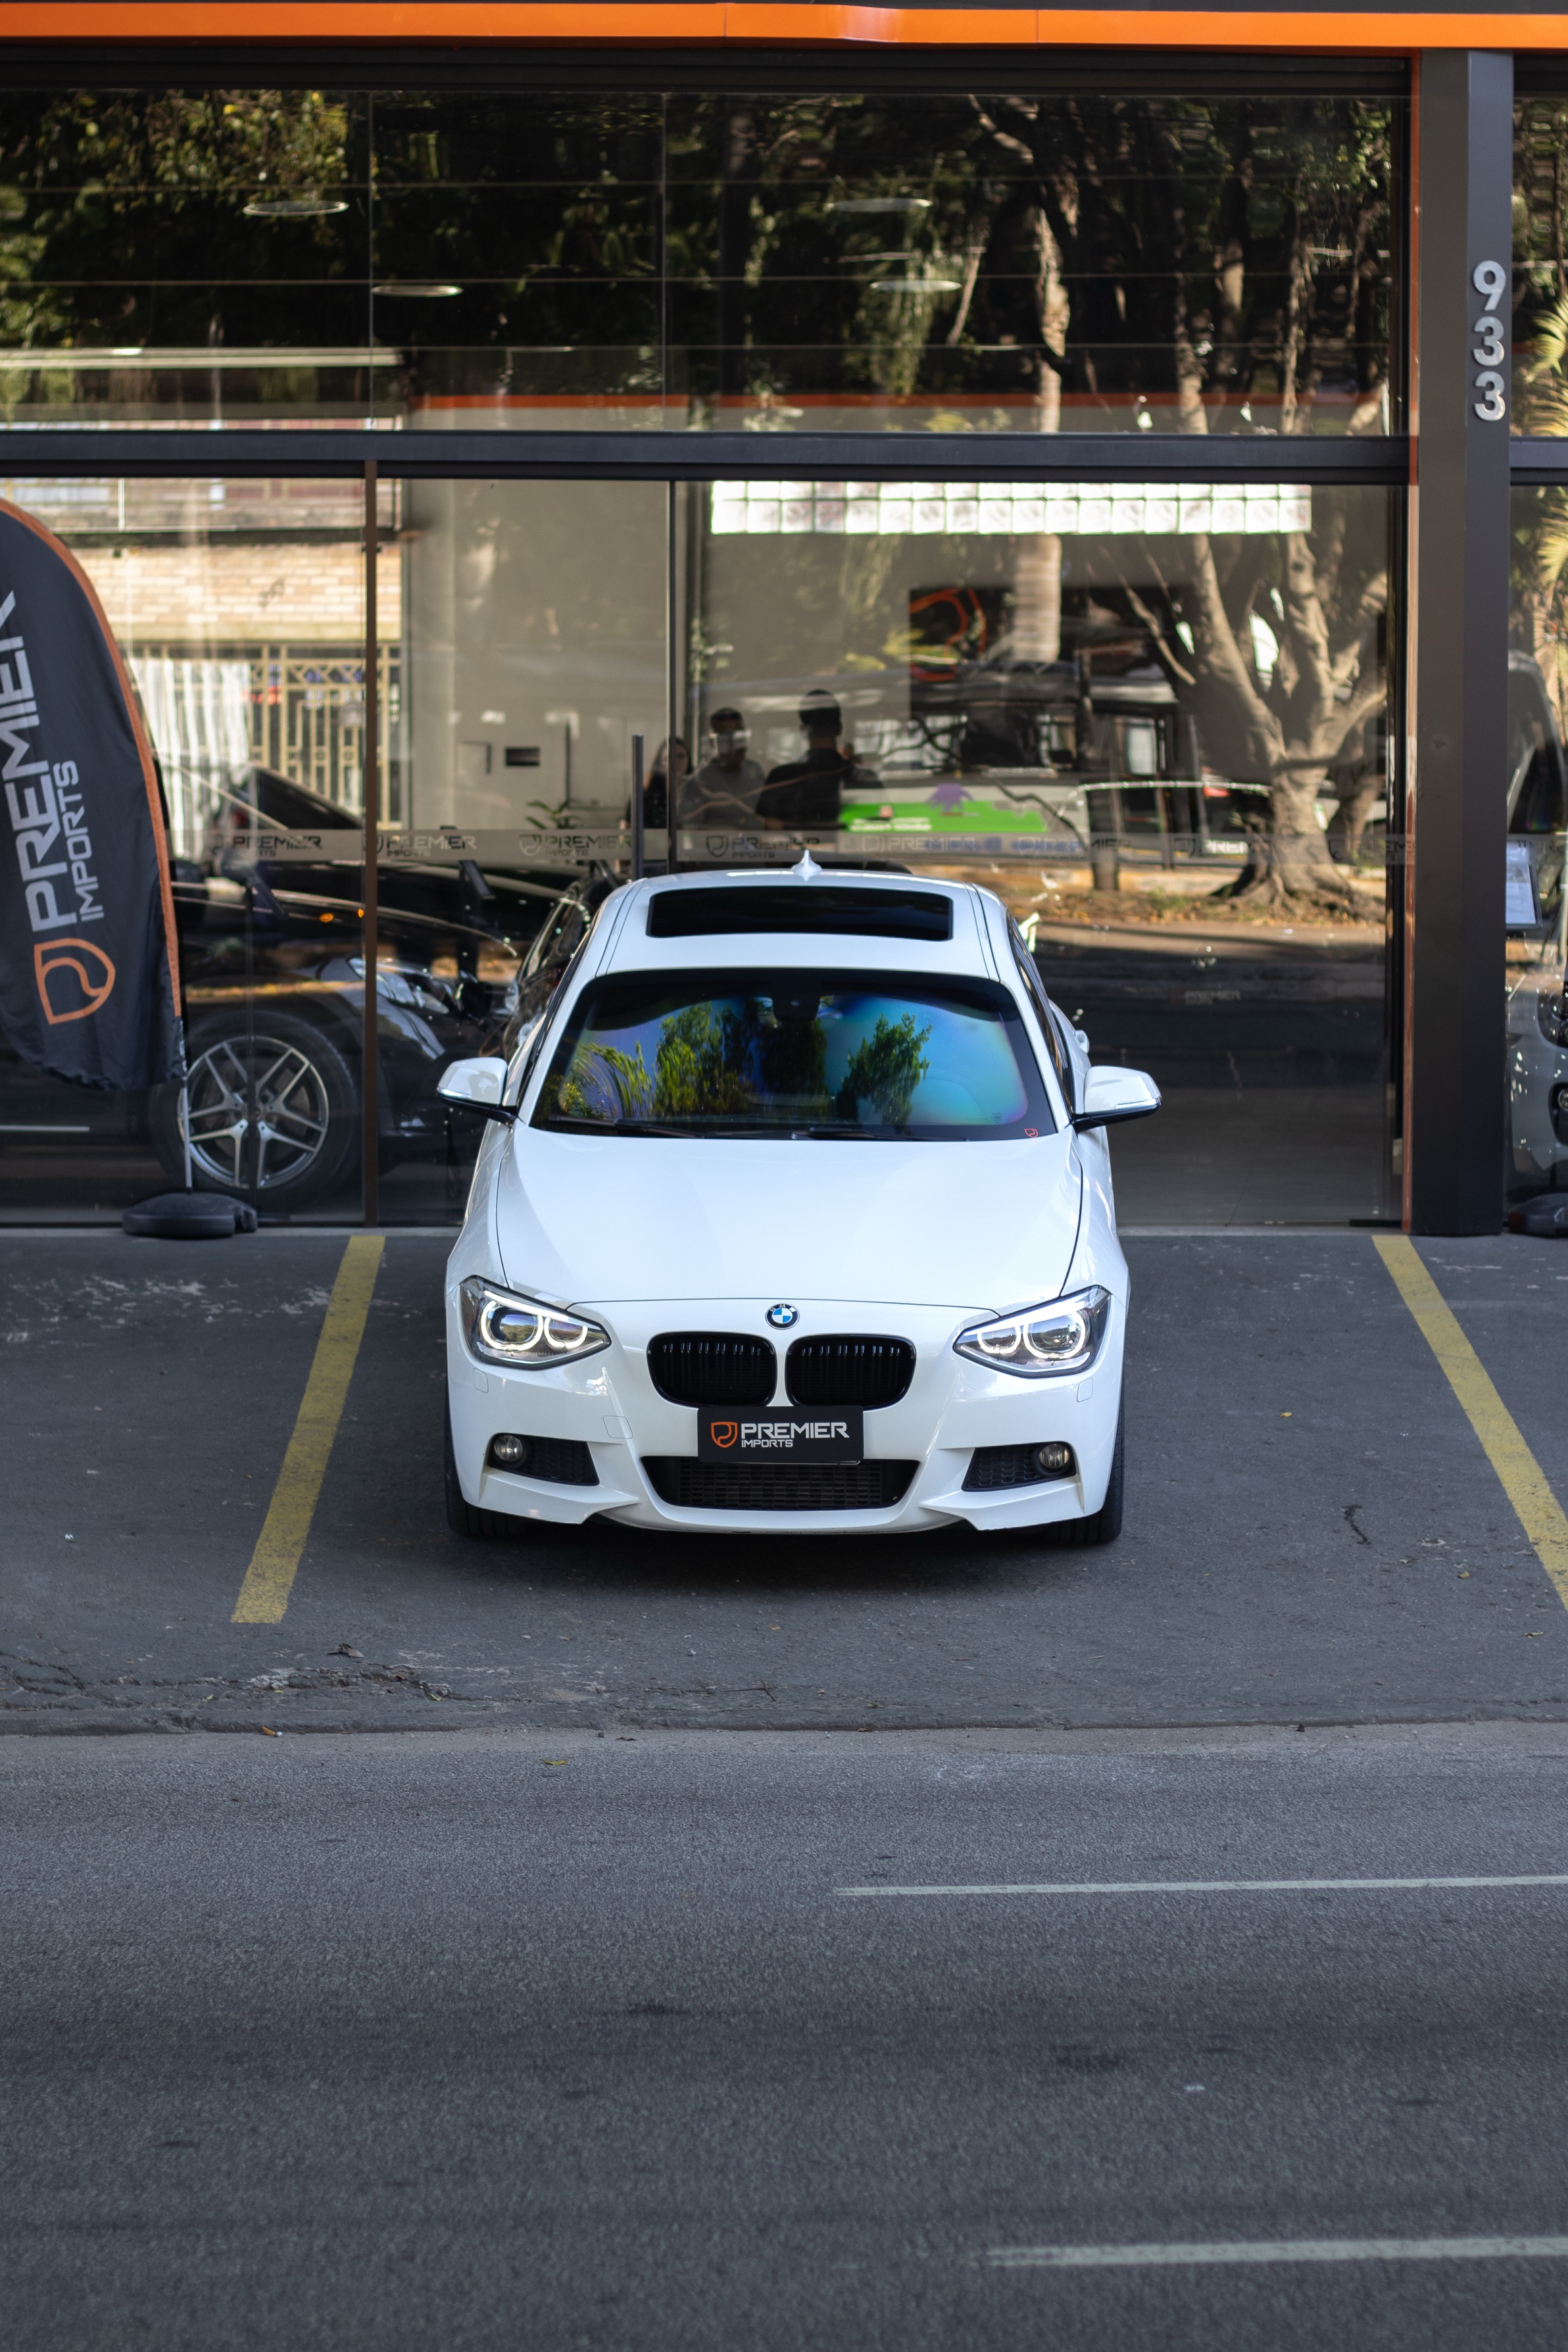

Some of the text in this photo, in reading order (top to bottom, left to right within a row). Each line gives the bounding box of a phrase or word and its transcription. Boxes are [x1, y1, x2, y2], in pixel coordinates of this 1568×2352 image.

[1473, 260, 1506, 421] 933
[54, 760, 104, 921] IMPORTS
[888, 837, 976, 850] PREMIER
[770, 1304, 796, 1313] BMW
[741, 1422, 850, 1439] PREMIER
[741, 1439, 793, 1448] IMPORTS
